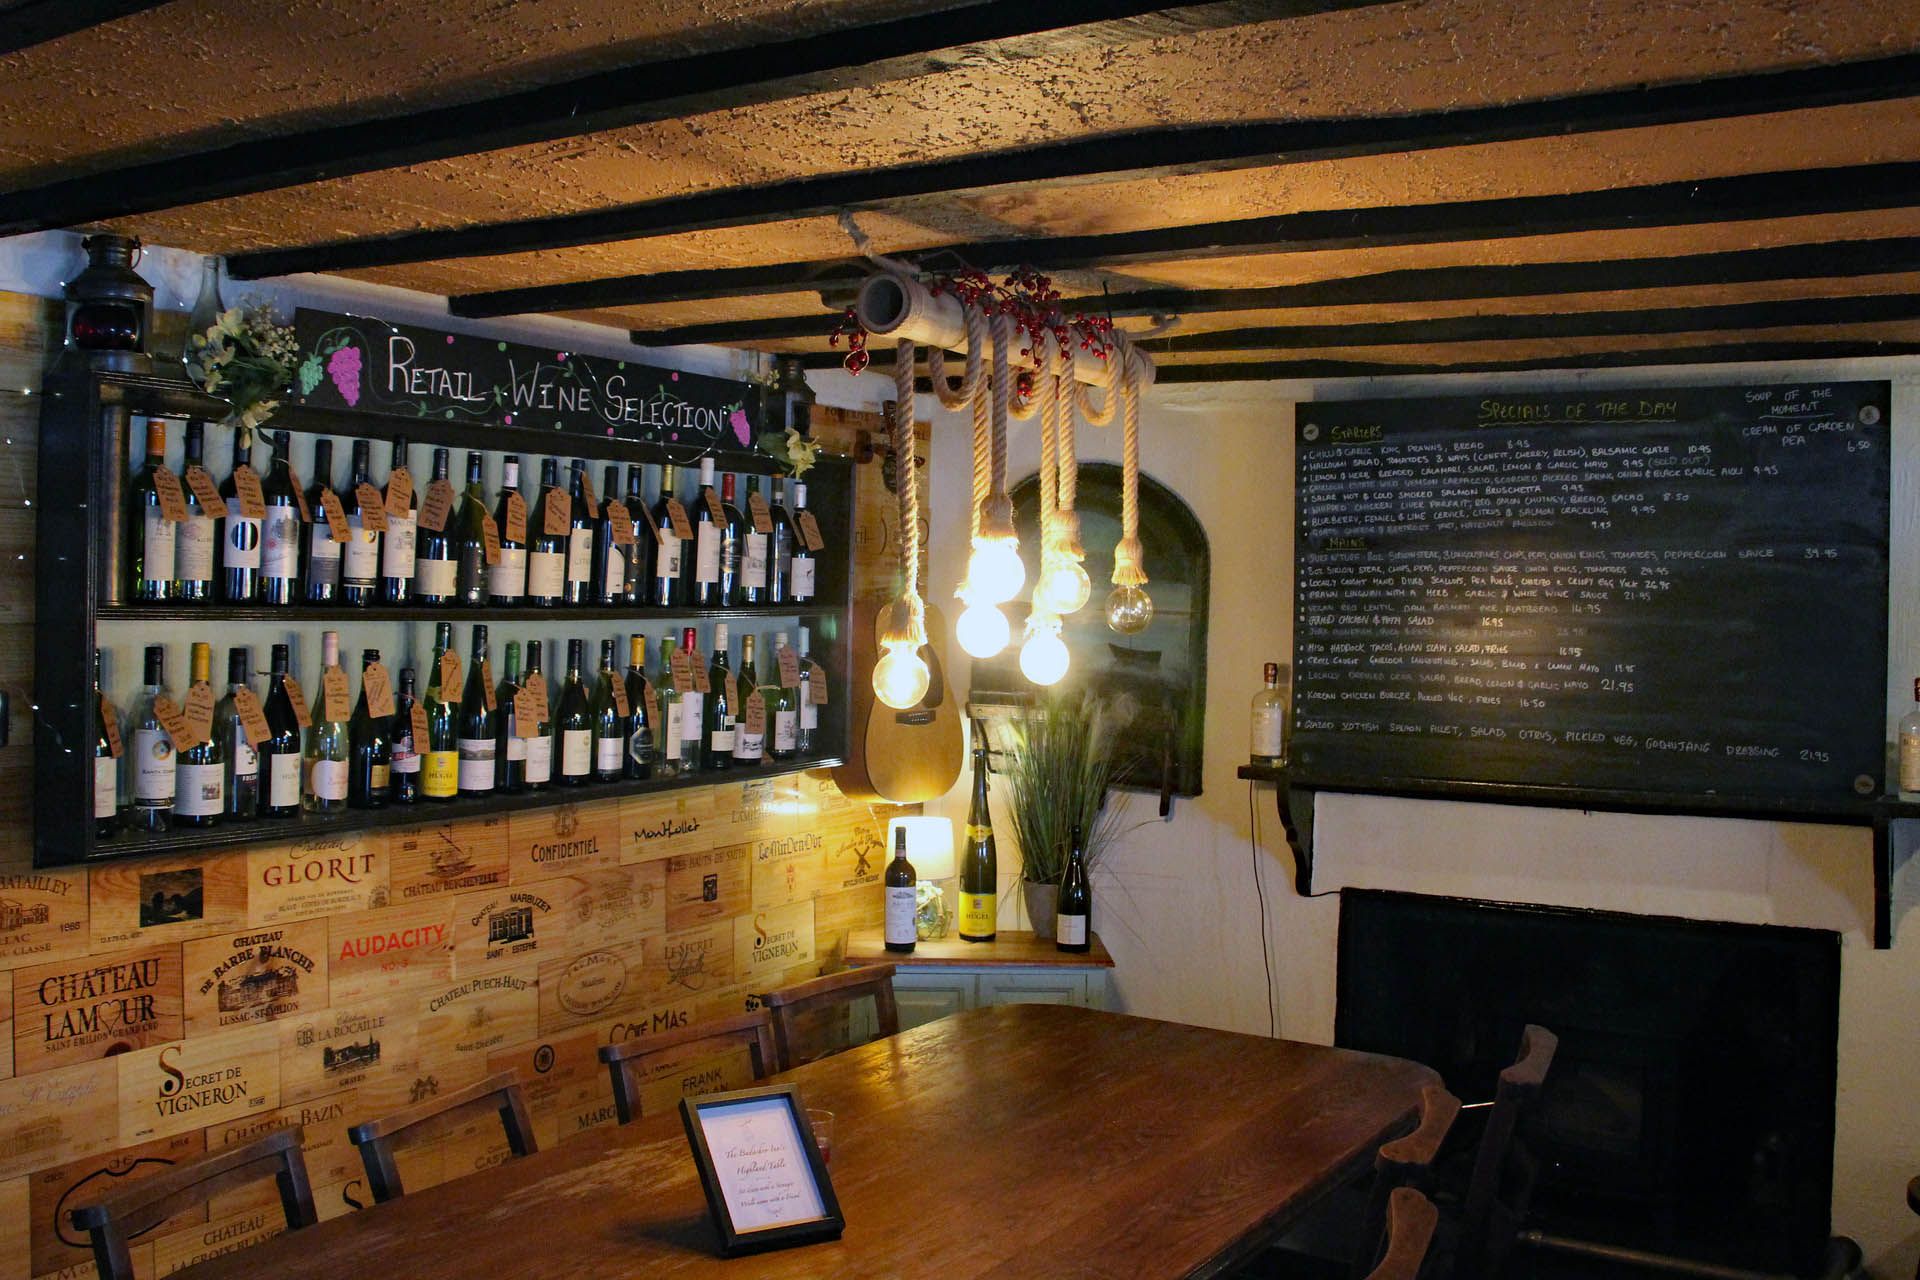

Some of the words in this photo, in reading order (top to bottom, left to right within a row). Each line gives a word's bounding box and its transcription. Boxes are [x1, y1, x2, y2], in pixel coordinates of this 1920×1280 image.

[387, 335, 486, 402] RETAIL
[508, 358, 591, 411] WINE
[604, 374, 727, 433] SELECTION
[1745, 391, 1772, 403] SOUP
[1784, 389, 1800, 401] OF
[1812, 388, 1832, 398] THE
[1478, 400, 1550, 419] SPECIALS
[1566, 402, 1586, 417] OF
[1595, 401, 1631, 417] THE
[1639, 400, 1677, 417] DAY
[1771, 401, 1821, 415] MOMENT
[1329, 425, 1383, 441] STARTERS
[1742, 424, 1778, 437] CREAM
[1786, 423, 1801, 434] OF
[1808, 422, 1856, 433] GARDEN
[1781, 435, 1806, 447] PEA
[1591, 447, 1637, 457] BALSAMIC
[1502, 463, 1531, 471] LEMON
[1584, 460, 1608, 468] MAYO
[1441, 488, 1478, 497] SALMON
[1485, 485, 1542, 495] BRUSCHETTA
[1329, 538, 1365, 548] MAINS
[1738, 548, 1775, 559] SAUCE
[1308, 589, 1338, 600] PRAWN
[1465, 589, 1497, 599] GARLIC
[1545, 589, 1569, 599] WINE
[1579, 589, 1609, 600] SAUCE
[1407, 615, 1435, 626] SALAD
[1563, 681, 1589, 690] MAYO
[1476, 695, 1501, 706] FRIES
[1565, 730, 1606, 744] PICKLED
[530, 835, 600, 863] CONFIDENTIEL
[263, 853, 376, 887] GLORIT
[510, 893, 552, 913] MARBUZET
[232, 929, 284, 949] CHATEAU
[339, 923, 446, 961] AUDACITY
[752, 940, 800, 965] VIGNERON
[38, 957, 161, 1007] CHATEAU
[226, 1066, 242, 1080] DE
[682, 1067, 722, 1092] FRANK
[155, 1081, 248, 1118] VIGNERON
[300, 1103, 346, 1129] BAZIN
[202, 1214, 266, 1247] CHATEAU
